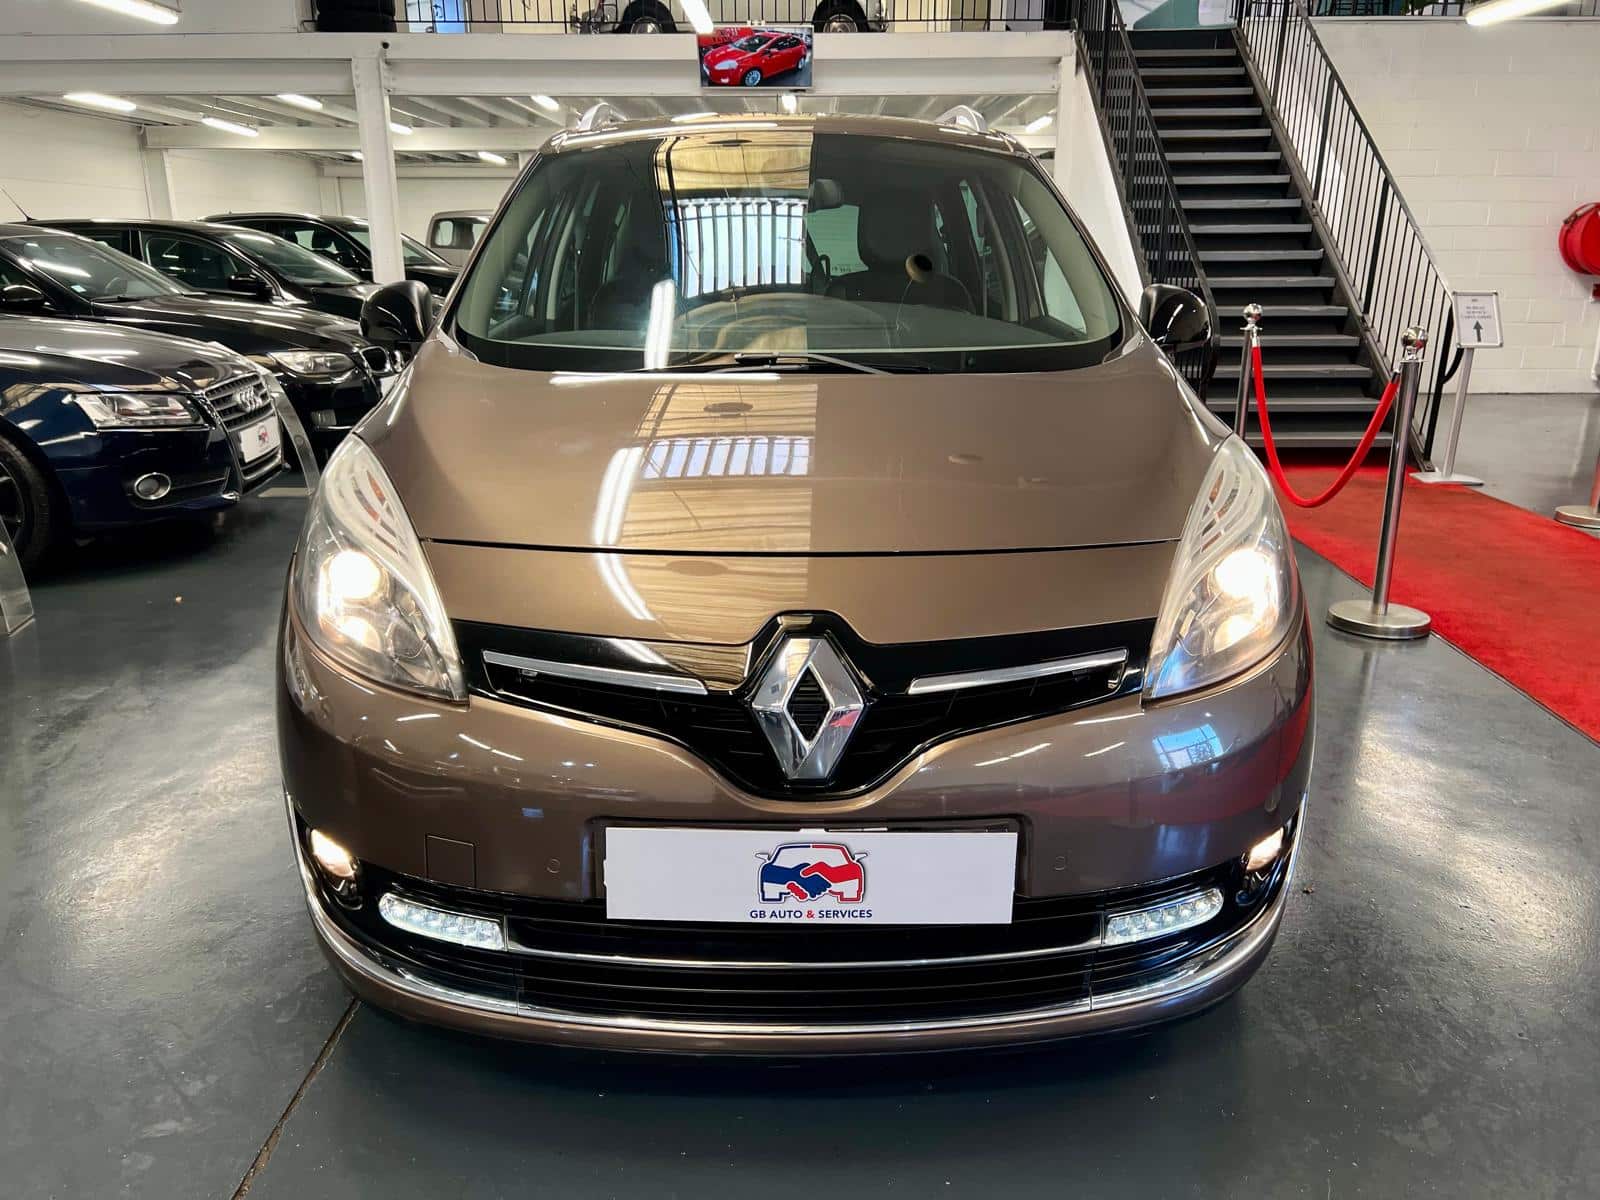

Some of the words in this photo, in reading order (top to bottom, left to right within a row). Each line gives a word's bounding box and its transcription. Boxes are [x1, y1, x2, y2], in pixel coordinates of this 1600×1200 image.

[750, 910, 766, 918] GB
[769, 910, 803, 918] AUTO
[806, 910, 815, 918] &
[818, 909, 873, 918] SERVICES
